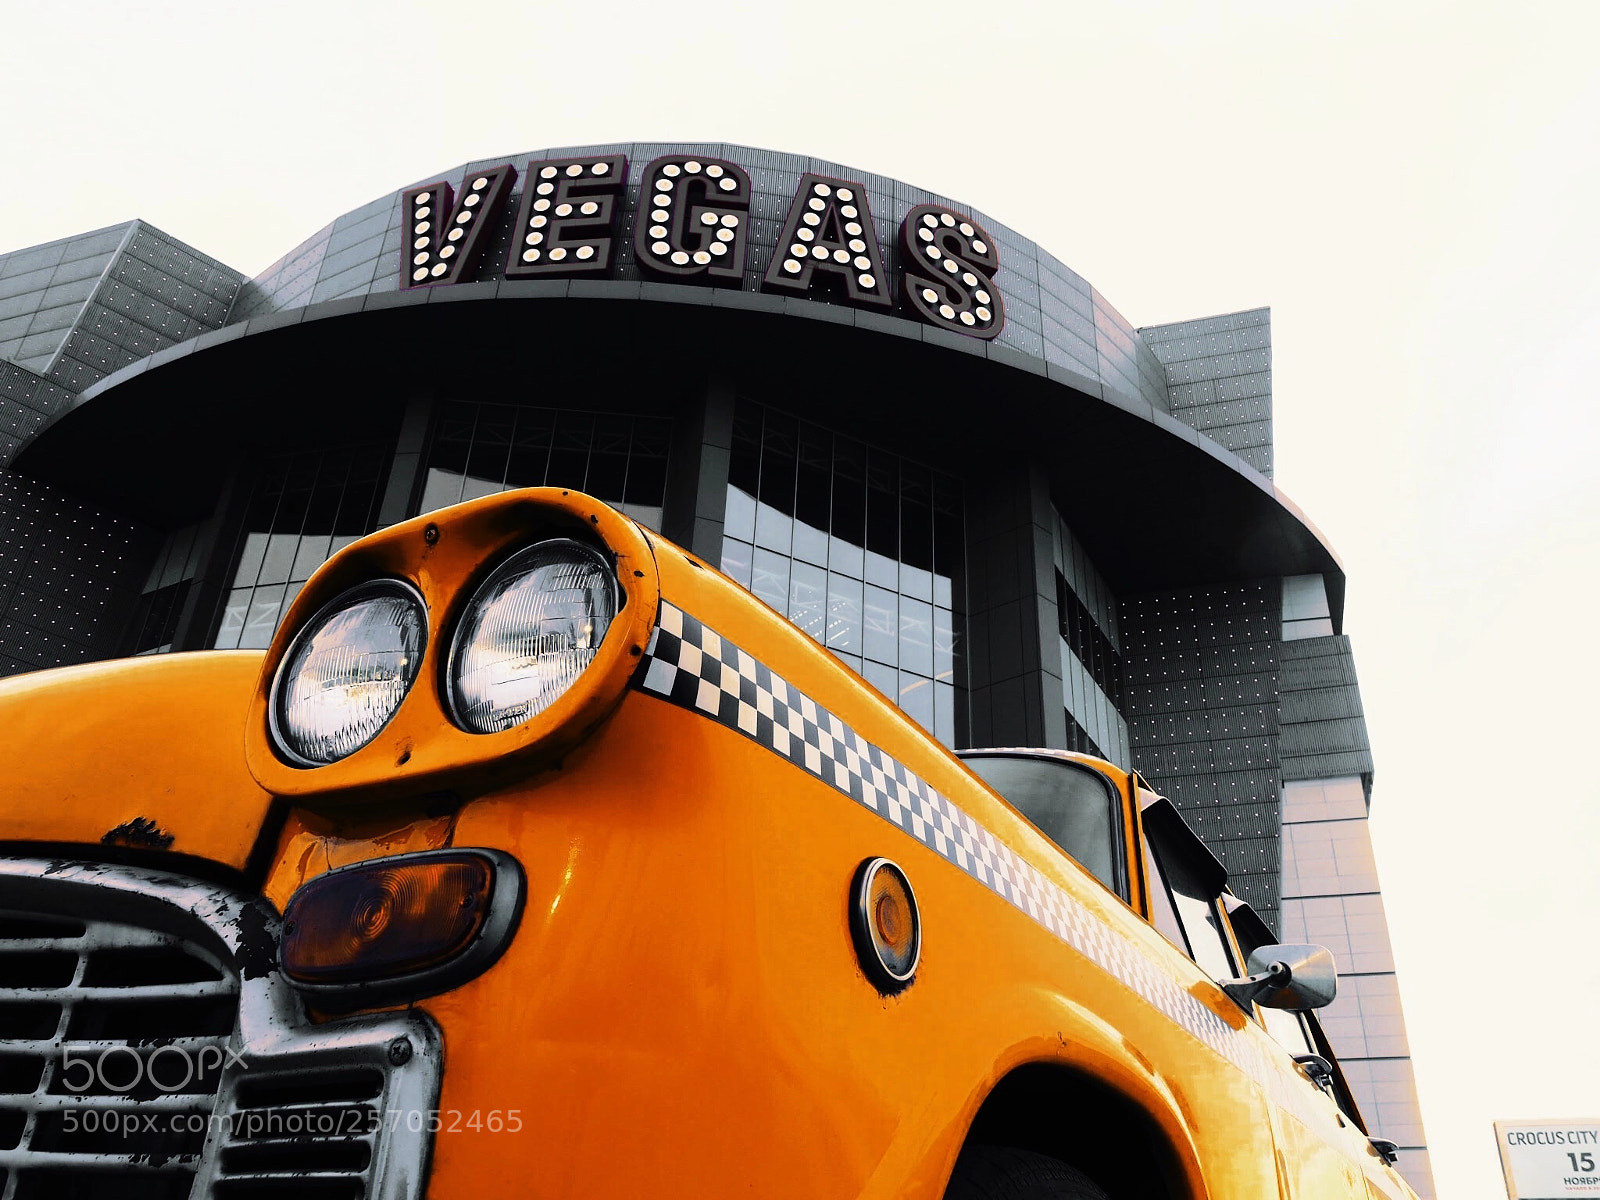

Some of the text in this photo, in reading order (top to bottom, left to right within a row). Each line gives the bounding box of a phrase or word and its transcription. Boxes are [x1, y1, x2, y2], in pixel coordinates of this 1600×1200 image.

[400, 154, 1004, 340] VEGAS
[1507, 1130, 1598, 1146] CROCUS CITY
[1566, 1152, 1596, 1172] 15
